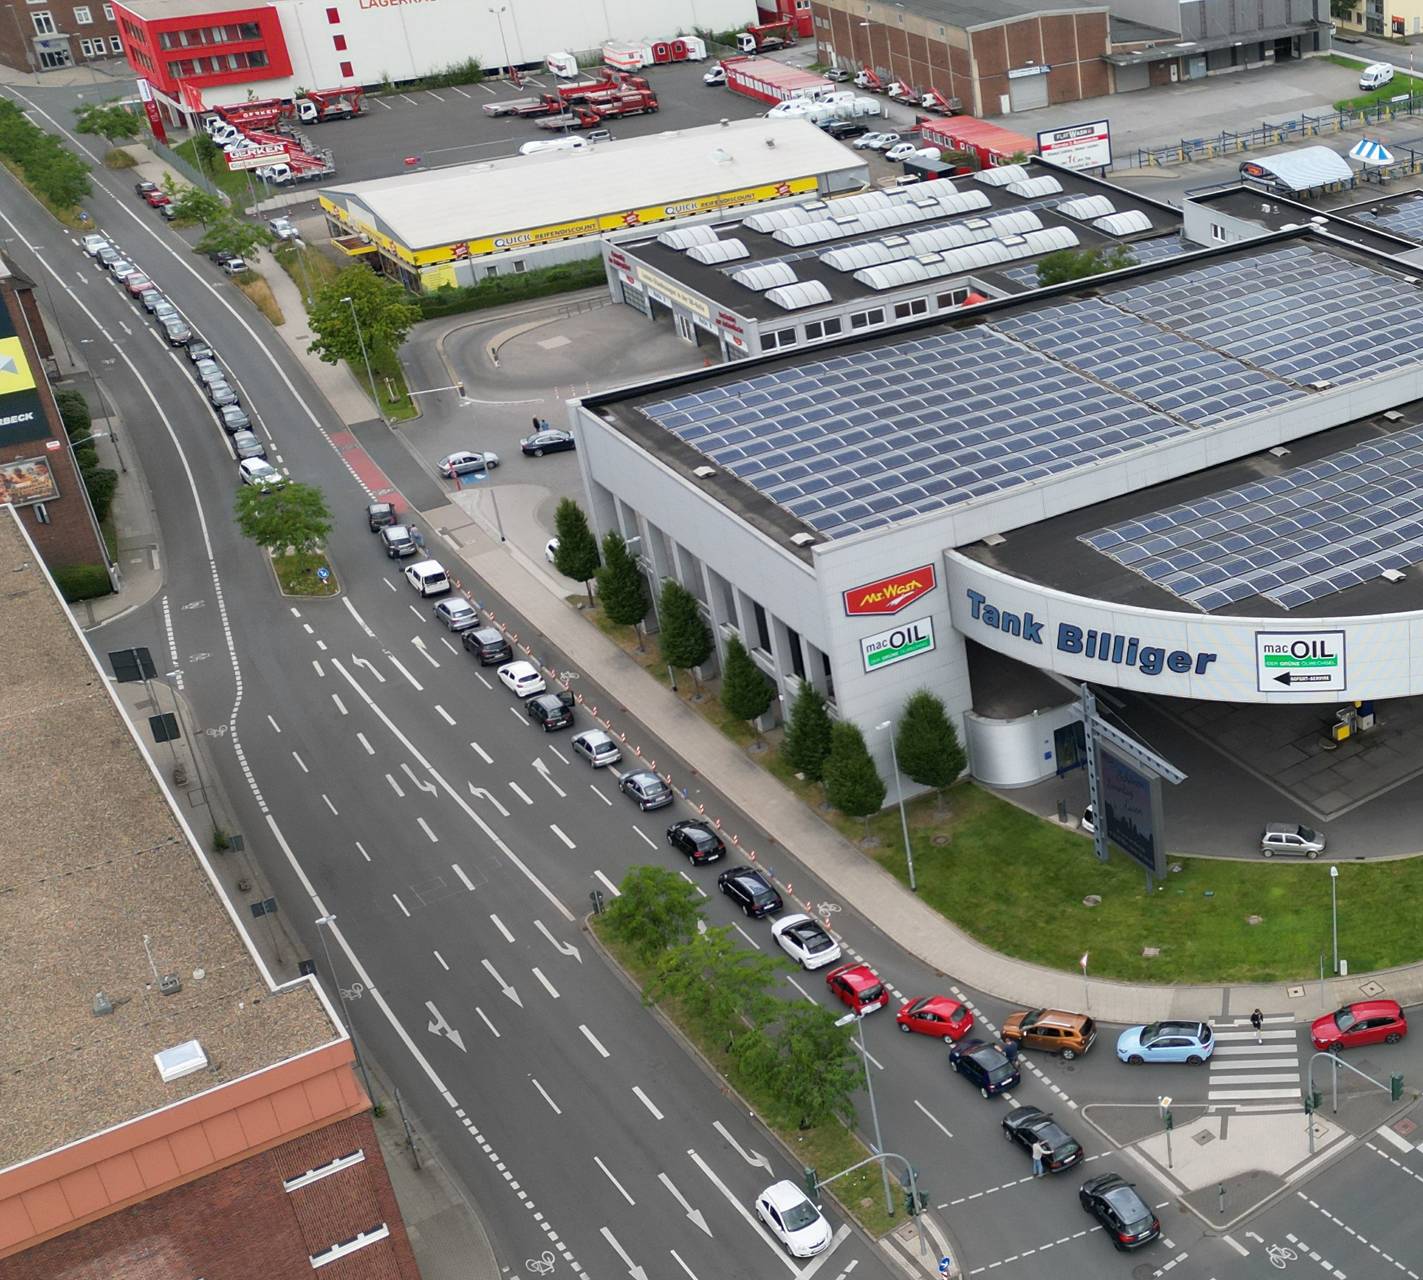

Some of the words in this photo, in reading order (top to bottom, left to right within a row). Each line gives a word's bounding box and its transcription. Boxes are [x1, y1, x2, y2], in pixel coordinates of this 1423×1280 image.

[495, 234, 531, 247] QUICK
[966, 589, 1044, 644] Tank
[1056, 622, 1217, 675] Billiger
